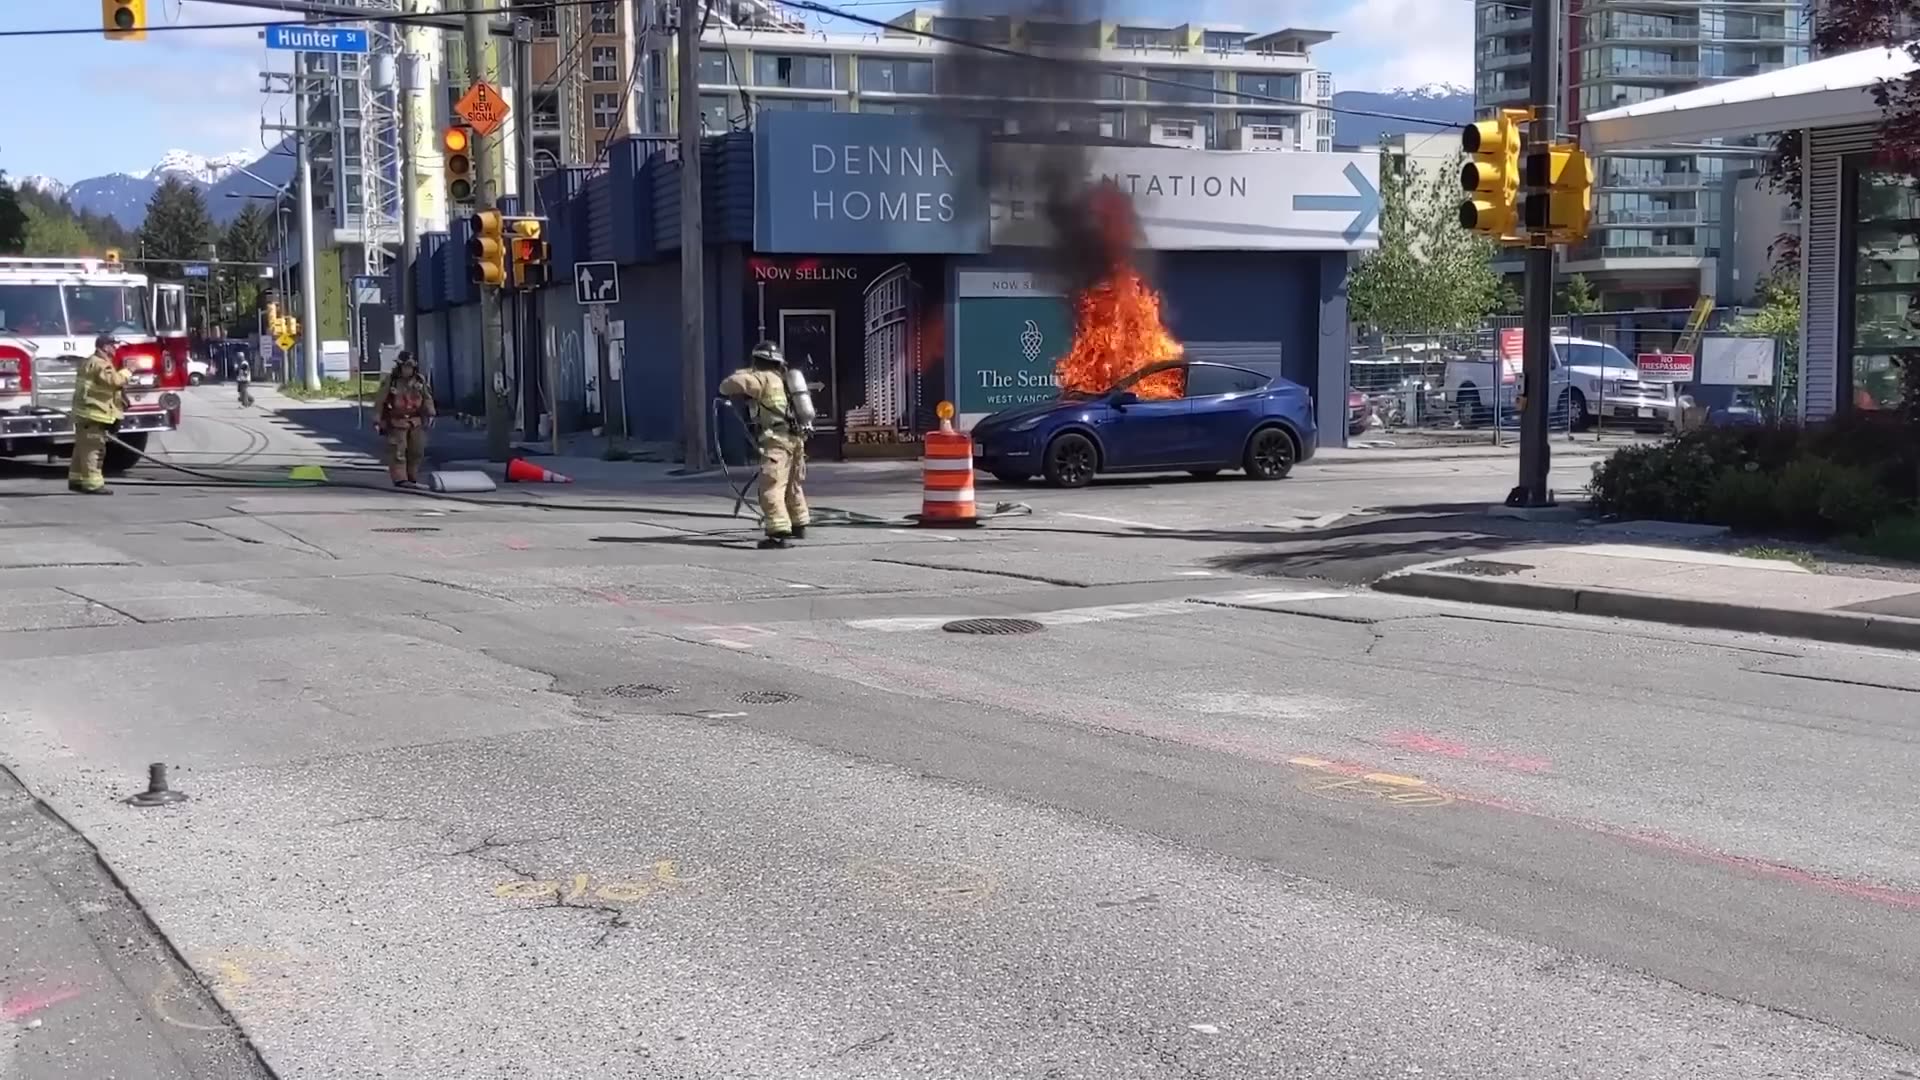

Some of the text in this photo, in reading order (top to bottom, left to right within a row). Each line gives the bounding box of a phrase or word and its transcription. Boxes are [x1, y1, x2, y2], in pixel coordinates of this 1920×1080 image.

[278, 29, 356, 47] Hunter St
[472, 102, 492, 111] NEW
[467, 112, 498, 121] SIGNAL
[812, 144, 954, 176] DENNA
[813, 190, 954, 222] HOMES
[755, 267, 857, 280] NOW SELLING
[992, 281, 1018, 290] NOW
[977, 370, 1013, 387] The
[987, 396, 1012, 404] WEST
